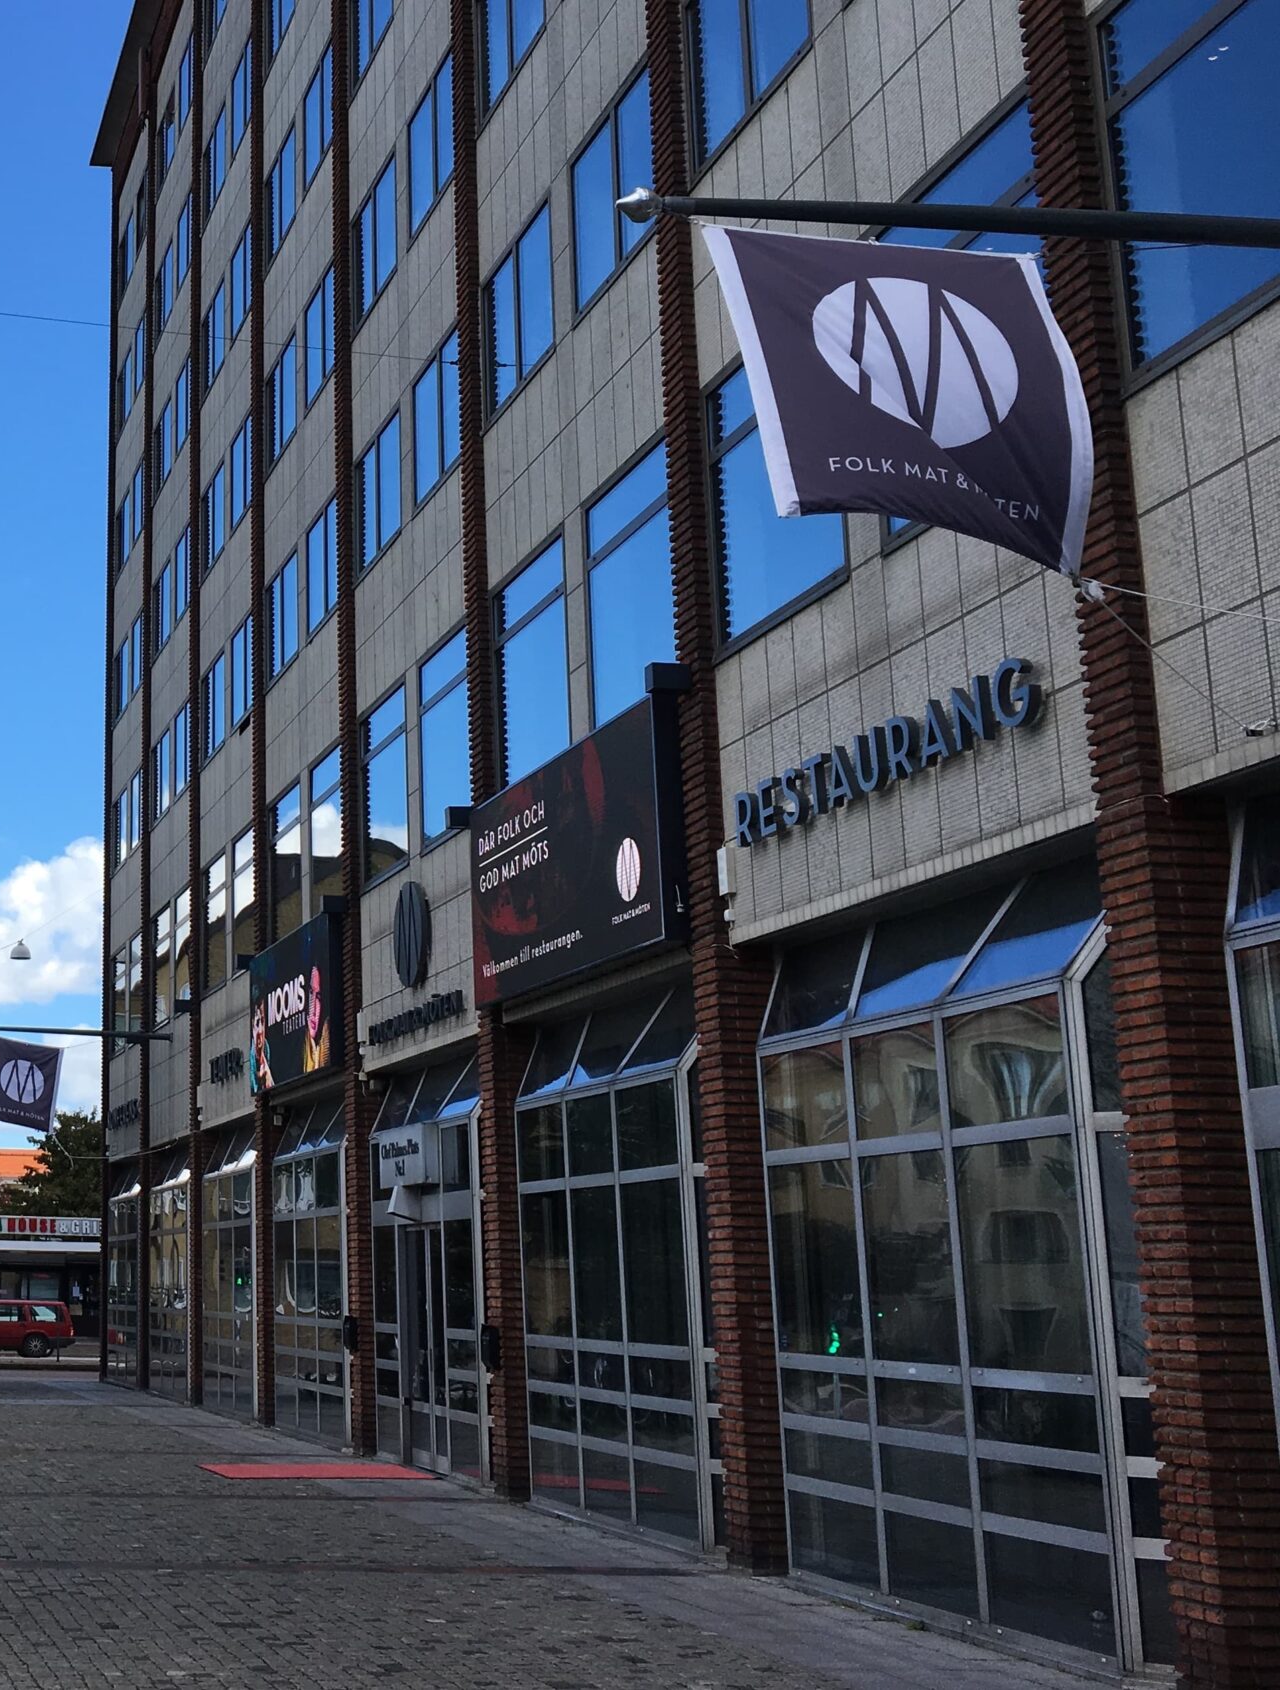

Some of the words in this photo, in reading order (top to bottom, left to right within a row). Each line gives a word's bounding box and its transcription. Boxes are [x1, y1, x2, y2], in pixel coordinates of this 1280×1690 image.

[828, 456, 895, 474] FOLK
[904, 461, 948, 484] MAT
[956, 472, 969, 490] &
[974, 483, 1039, 521] TEN
[733, 657, 1042, 847] RESTAURANG
[478, 829, 495, 857] DÄR
[497, 814, 521, 846] FOLK
[523, 799, 545, 829] OCH
[480, 867, 499, 893] GOD
[501, 855, 520, 883] MAT
[522, 840, 549, 871] MÖTS
[482, 956, 519, 978] Välkommen
[520, 945, 530, 963] till
[531, 929, 583, 958] restaurangen.
[267, 974, 305, 1027] MOOMS
[7, 1217, 57, 1234] HOUSE
[71, 1220, 99, 1234] GRI
